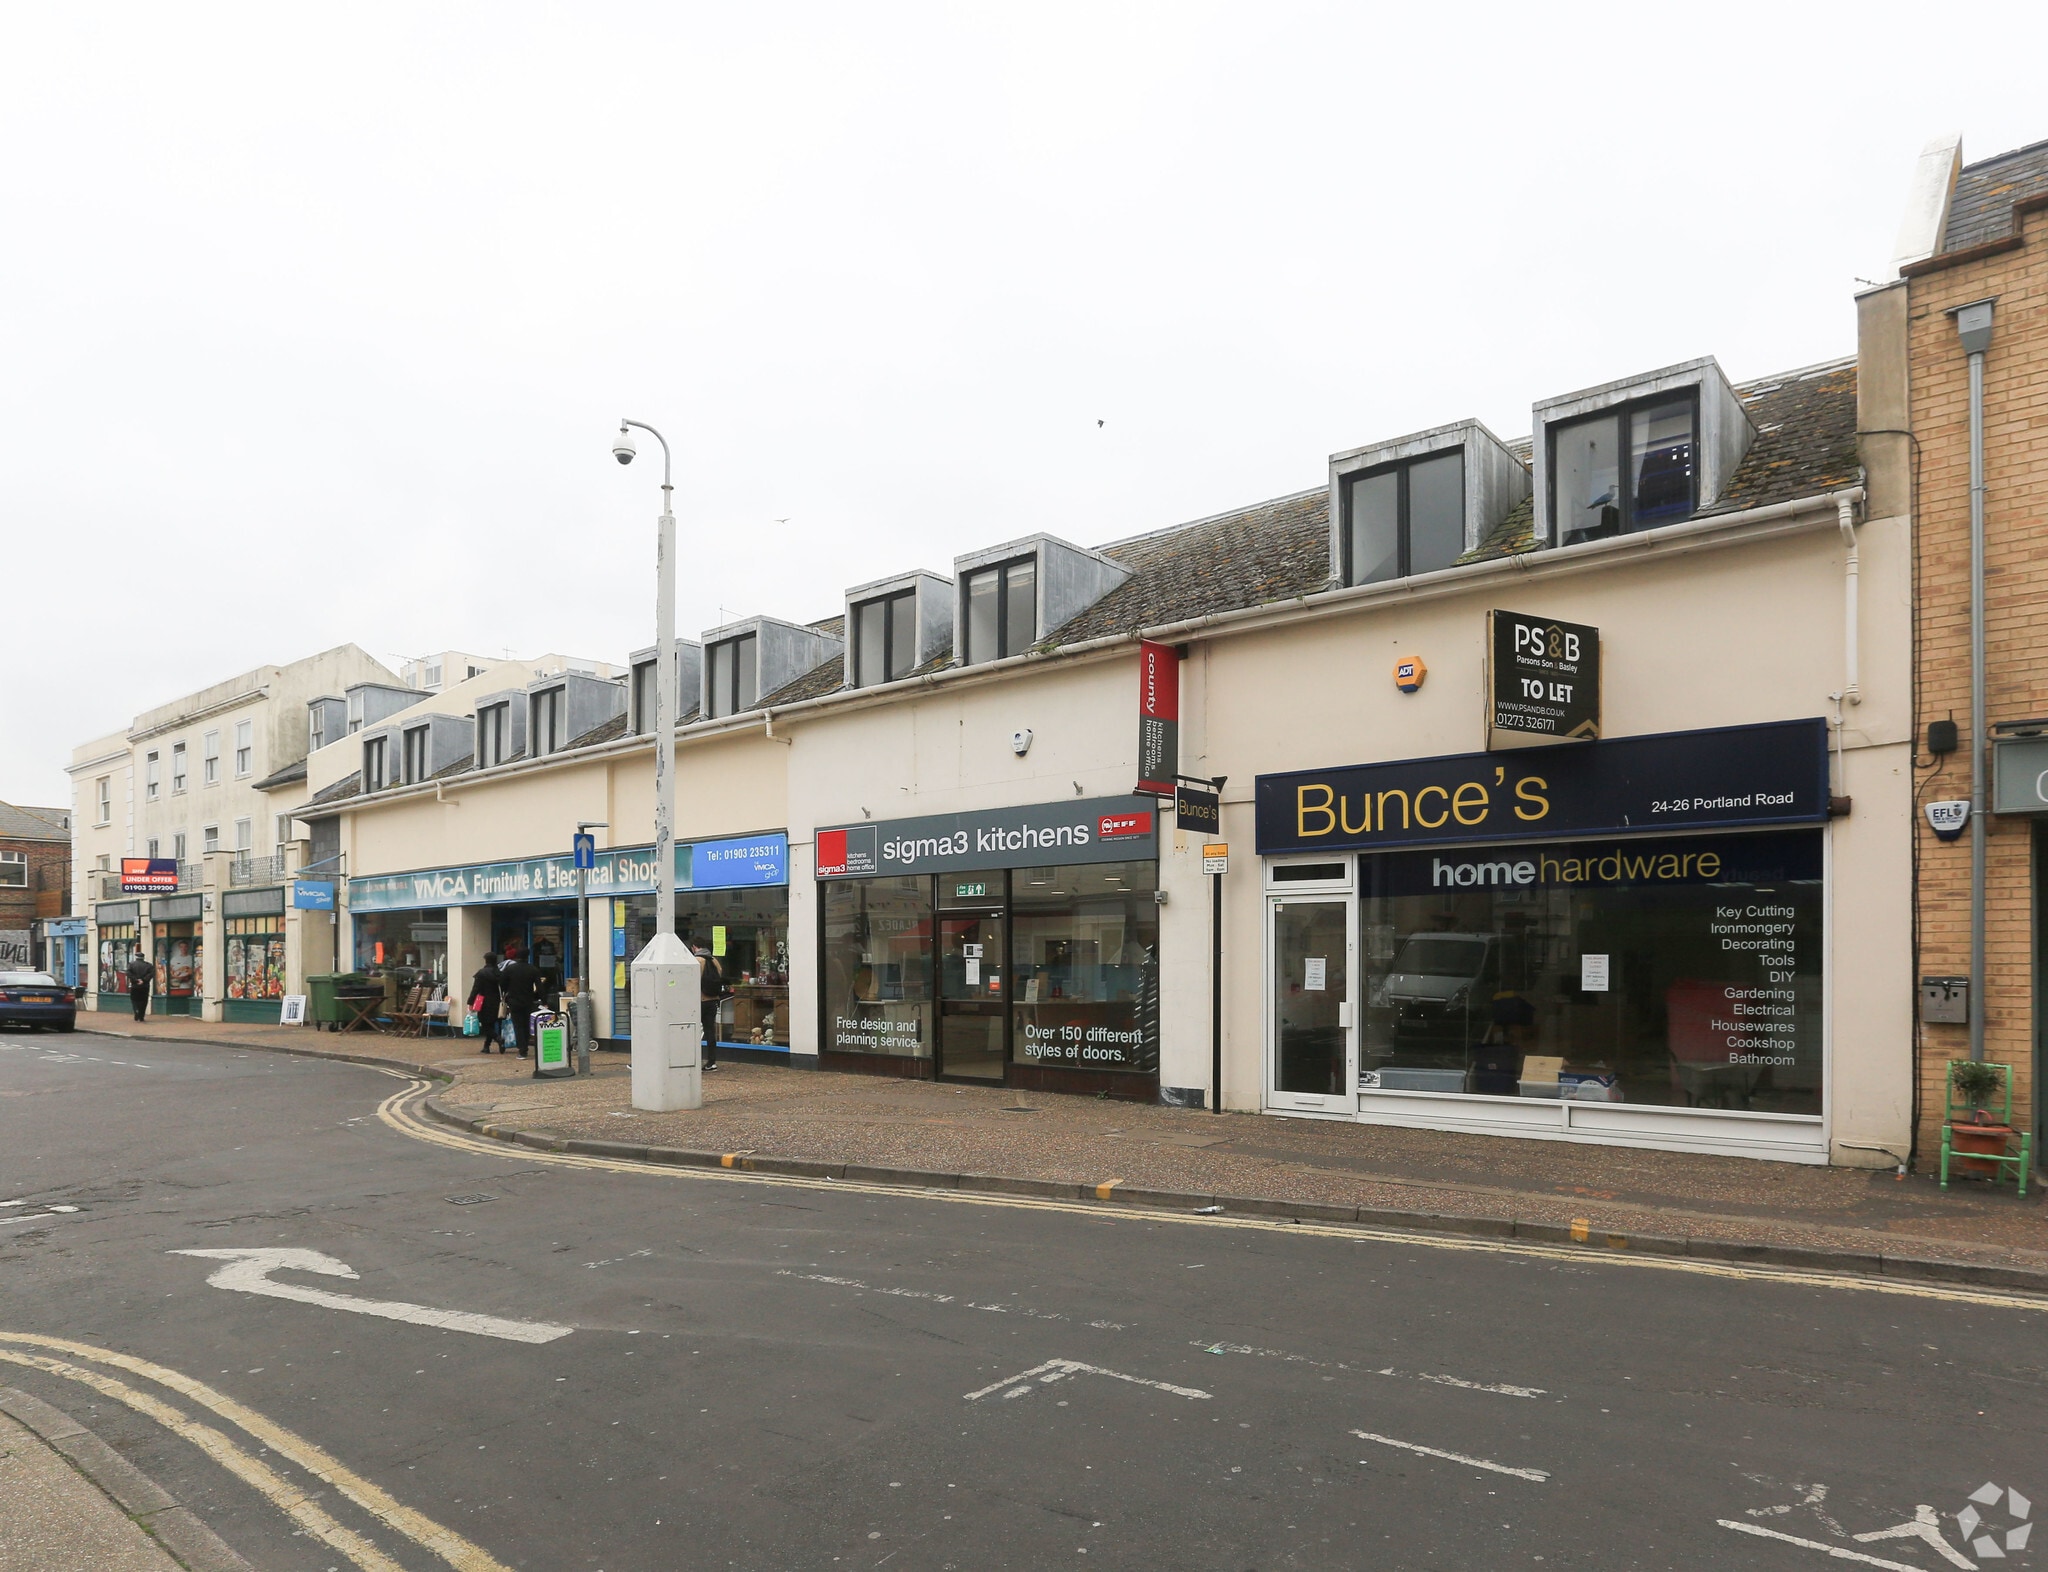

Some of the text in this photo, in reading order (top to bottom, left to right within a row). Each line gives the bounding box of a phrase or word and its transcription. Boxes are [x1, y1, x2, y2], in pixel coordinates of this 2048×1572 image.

[1515, 623, 1580, 662] PS&B
[1399, 666, 1414, 676] ADT
[1516, 655, 1540, 666] Parsons
[1542, 659, 1554, 668] Son
[1558, 662, 1578, 674] Basley
[1146, 652, 1156, 714] county
[1521, 678, 1574, 704] TO LET
[1497, 701, 1566, 717] WWW.PSANDB.CO.UK
[1497, 712, 1555, 731] 01273 326171
[1145, 719, 1153, 747] home
[1179, 799, 1217, 820] Bunce's
[1297, 767, 1550, 837] Bunce's
[1651, 792, 1794, 813] 24-26 Portland Road
[1933, 808, 1953, 818] EFL
[707, 845, 779, 860] Tel: 01903 235311
[883, 824, 1090, 864] sigma3 kitchens
[473, 858, 658, 894] Furniture & Elecical Shop
[818, 864, 846, 875] sigma3
[1432, 849, 1721, 887] home hardware
[414, 876, 469, 899] YMCA
[1716, 905, 1795, 920] Key Cutting
[1711, 923, 1795, 936] Ironmongery
[1722, 938, 1795, 952] Decorating
[1758, 954, 1795, 966] Tools
[1769, 971, 1795, 982] DIY
[1724, 987, 1795, 1002] Gardening
[1733, 1003, 1795, 1016] Electrical
[836, 1016, 916, 1033] Free design and
[1711, 1019, 1795, 1032] Housewares
[836, 1031, 920, 1048] planning service.
[1025, 1024, 1143, 1044] Over 150 different
[1025, 1042, 1126, 1061] styles of doors.
[1726, 1036, 1795, 1051] Cookshop
[1729, 1052, 1795, 1066] Bathroom
